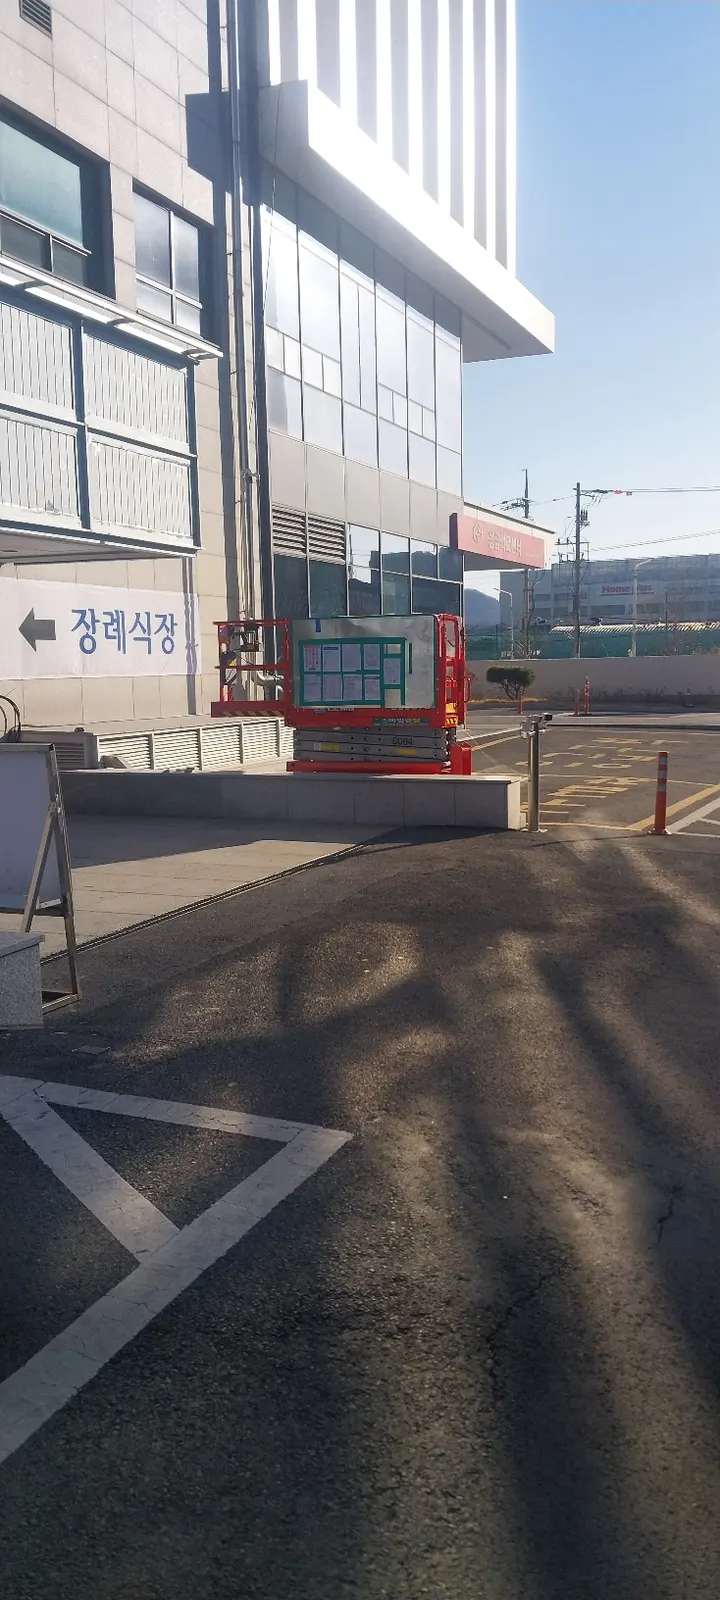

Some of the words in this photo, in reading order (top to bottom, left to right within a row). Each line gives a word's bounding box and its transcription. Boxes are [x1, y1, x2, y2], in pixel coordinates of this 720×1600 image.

[601, 586, 631, 594] Home
[71, 608, 178, 655] 장례식장
[392, 736, 413, 746] 6004
